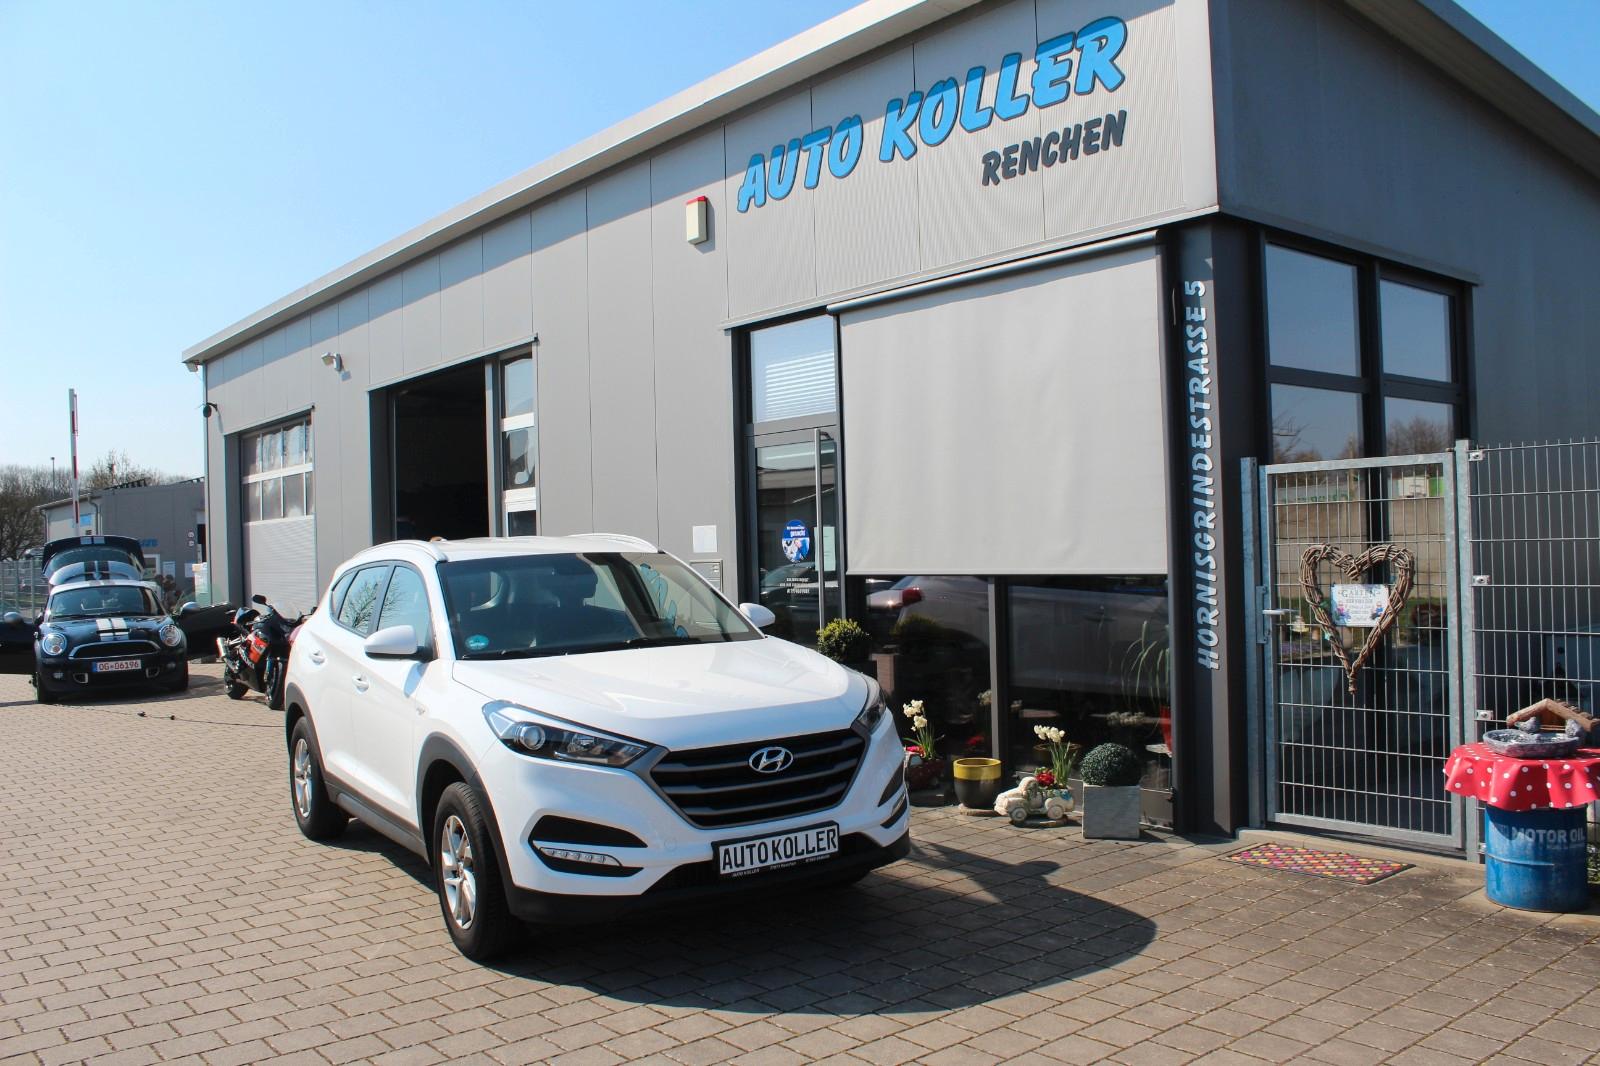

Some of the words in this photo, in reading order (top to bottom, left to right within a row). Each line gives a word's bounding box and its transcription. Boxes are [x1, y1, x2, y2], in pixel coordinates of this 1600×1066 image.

[737, 112, 864, 214] AUTO
[878, 15, 1129, 163] KOLLER
[981, 109, 1128, 187] RENCHEN
[1184, 280, 1206, 297] 5
[1186, 306, 1220, 670] HORNISGRINDESTRASSE
[722, 841, 769, 871] AUTO
[772, 828, 837, 862] KOLLER
[1511, 826, 1568, 843] MOTOR
[1569, 827, 1586, 842] OIL
